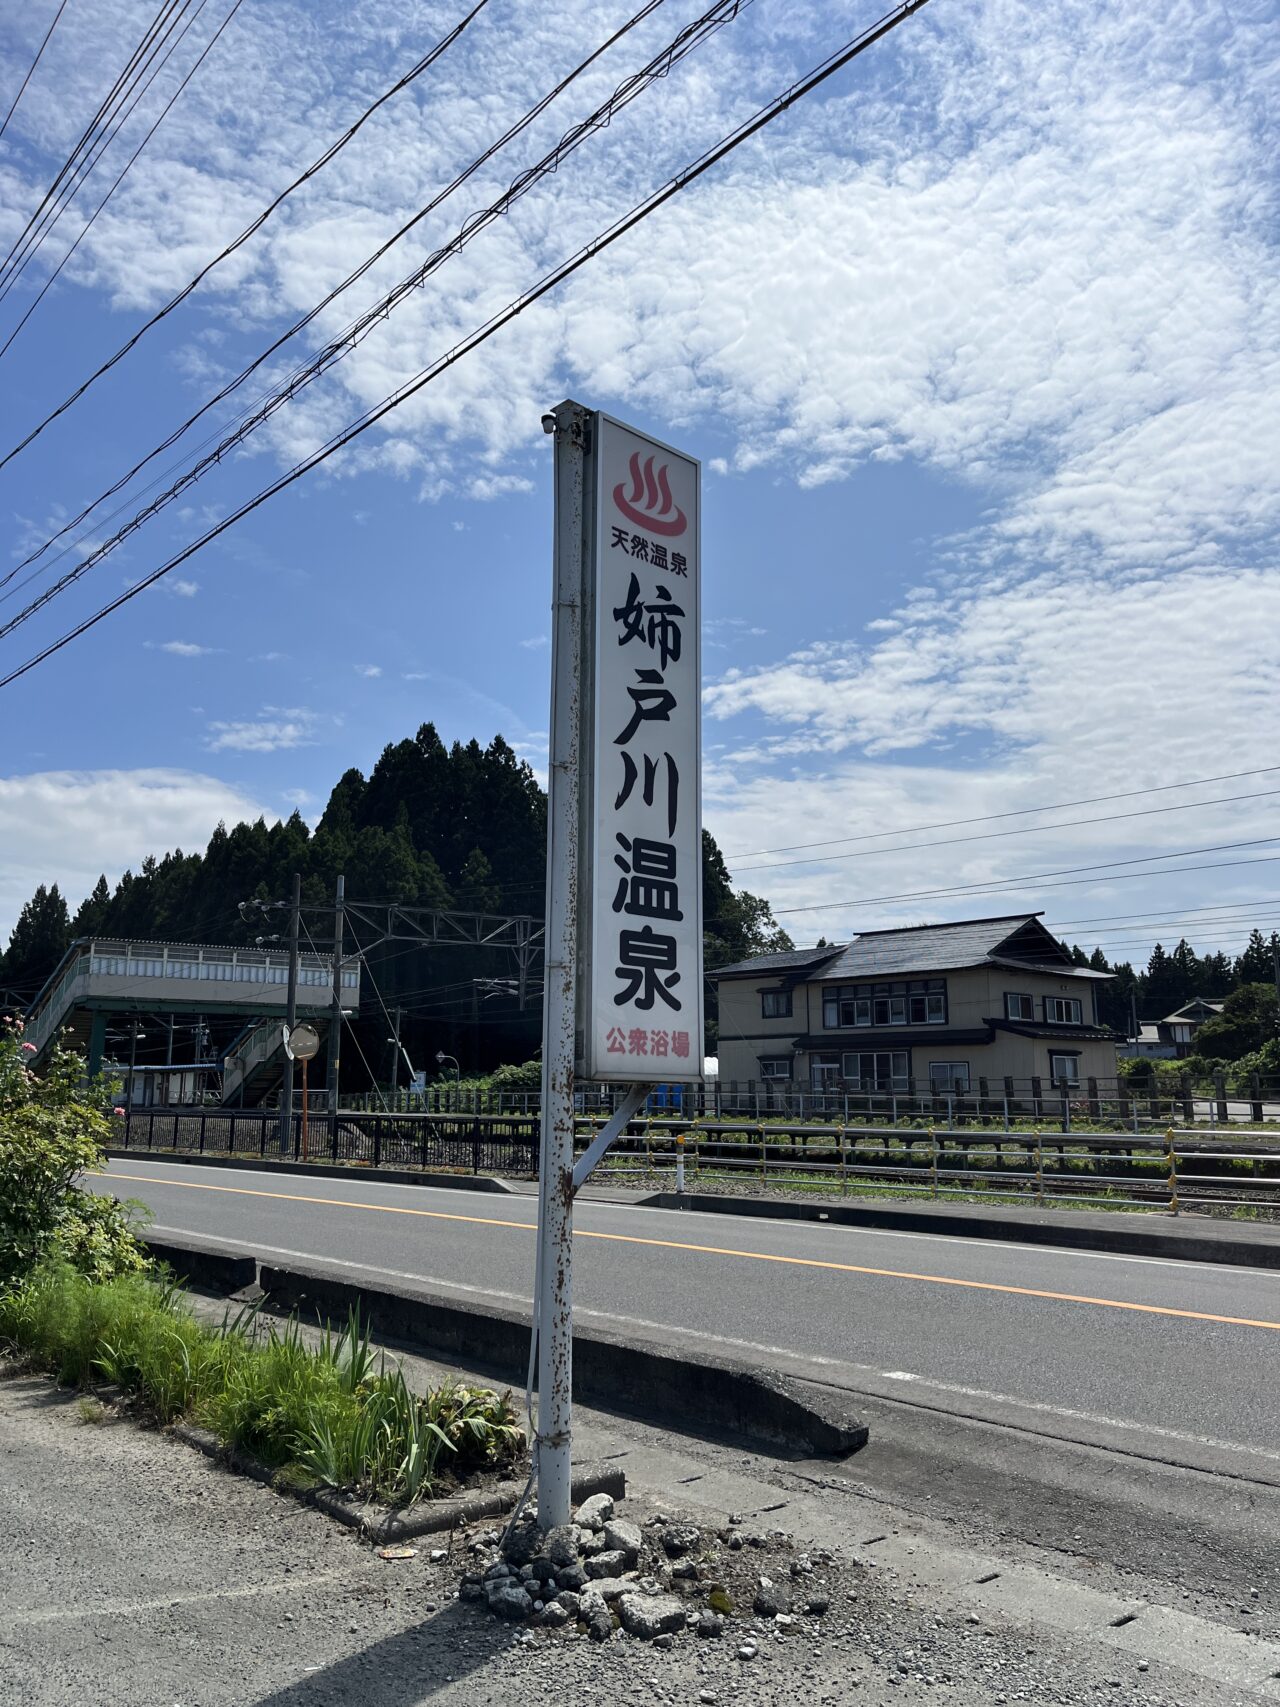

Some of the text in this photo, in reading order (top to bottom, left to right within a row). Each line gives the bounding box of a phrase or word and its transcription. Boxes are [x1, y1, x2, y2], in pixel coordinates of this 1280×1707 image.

[611, 526, 687, 578] 天然温泉
[612, 572, 685, 1011] 姉戸川温泉
[606, 1027, 690, 1058] 公衆浴場
